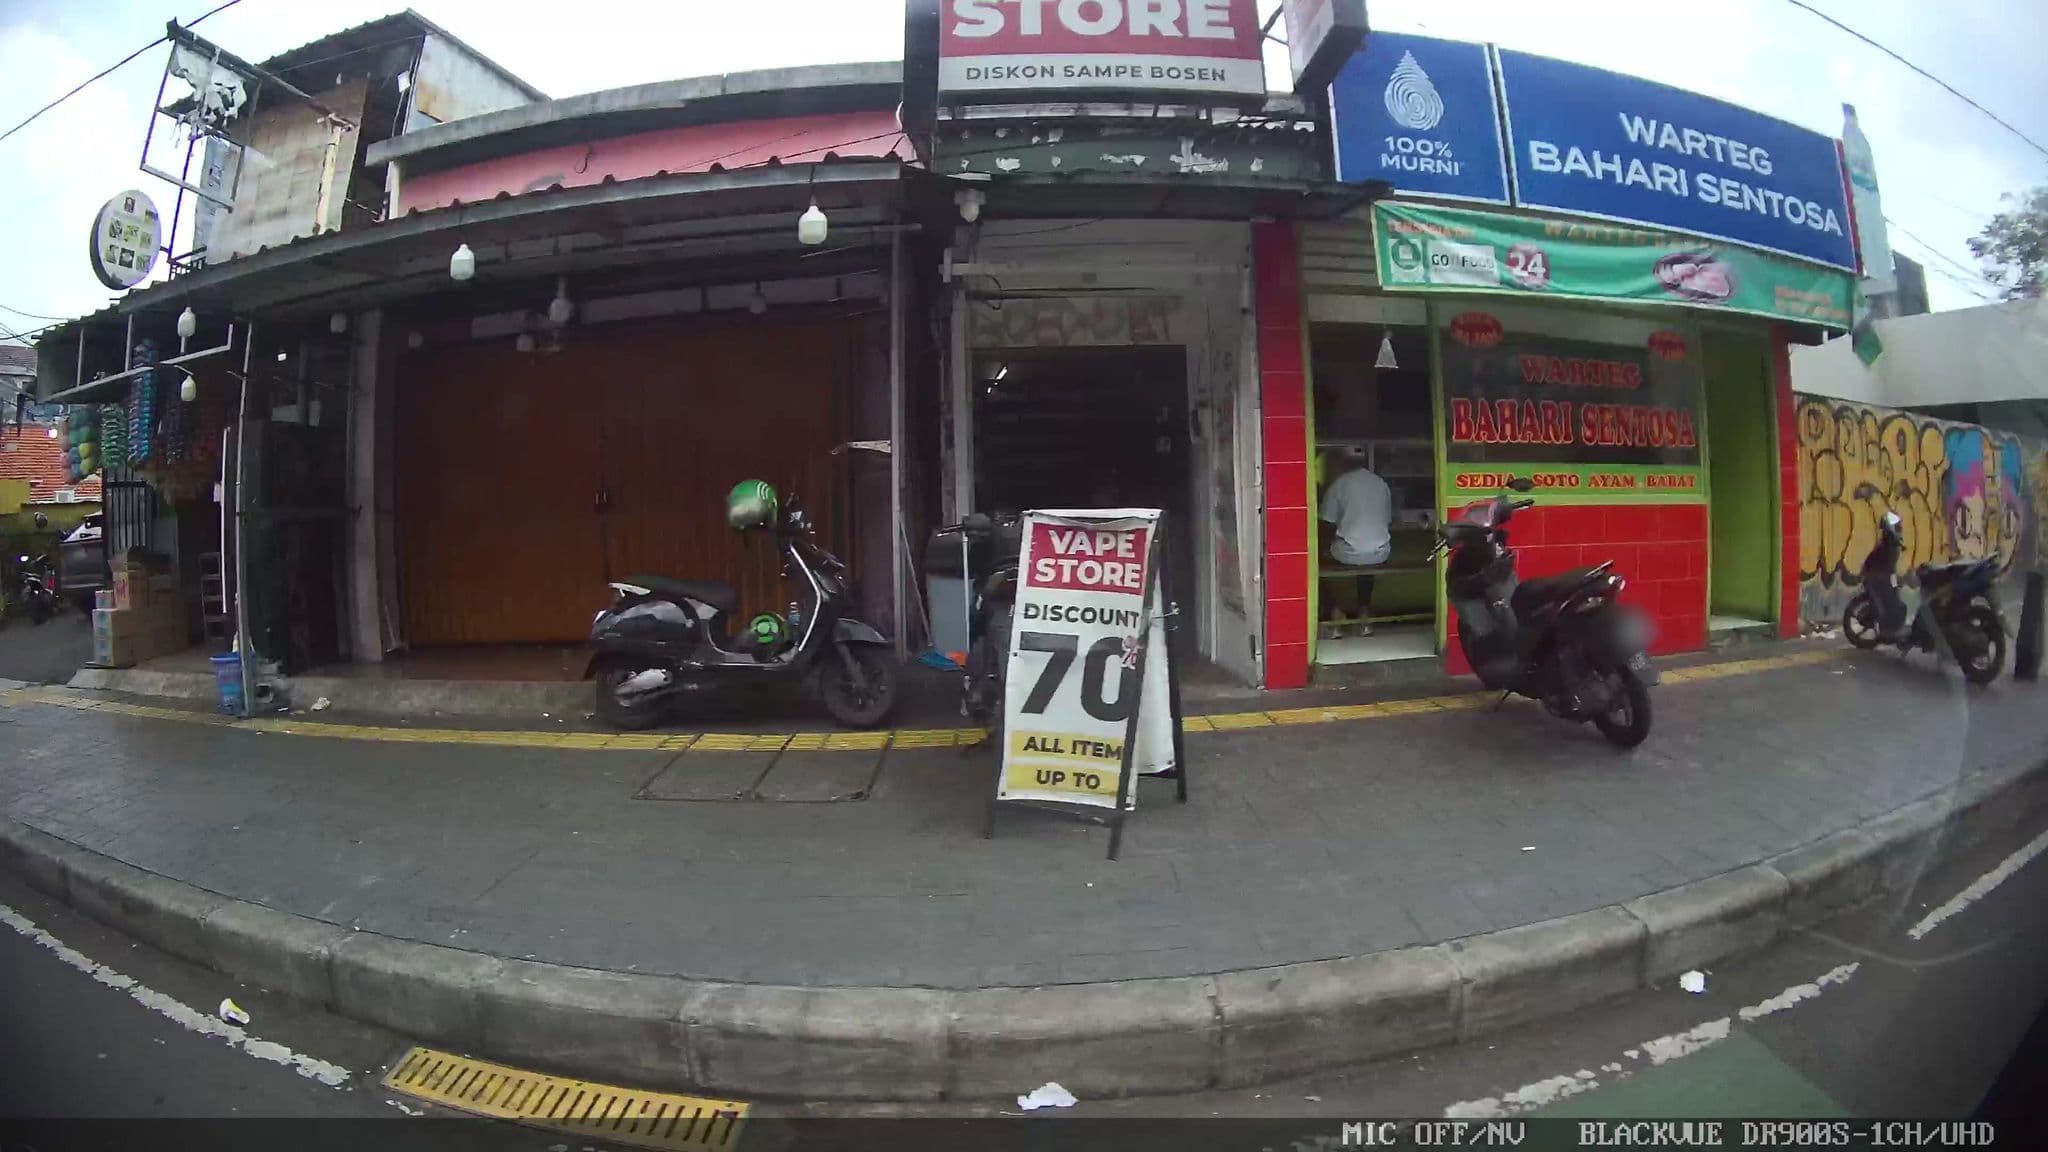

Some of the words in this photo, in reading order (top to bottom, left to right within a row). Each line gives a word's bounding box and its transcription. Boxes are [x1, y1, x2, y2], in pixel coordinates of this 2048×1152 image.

[952, 0, 1235, 40] STORE
[966, 64, 1055, 81] DISKON
[1063, 64, 1143, 79] SAMPE
[1151, 66, 1226, 82] BOSEN
[1383, 135, 1453, 159] 100%
[1619, 112, 1773, 176] WARTEG
[1381, 152, 1460, 177] MURNI
[1529, 140, 1688, 198] BAHARI
[1696, 172, 1844, 237] SENTOSA
[1510, 251, 1548, 280] 24
[1520, 354, 1643, 390] WARTEG
[1452, 397, 1575, 444] BAHARI
[1580, 403, 1697, 448] SENTOSA
[1531, 473, 1580, 489] SOTO
[1588, 474, 1636, 489] AYAM
[1049, 529, 1136, 559] VAPE
[1034, 558, 1142, 589] STORE
[1023, 602, 1140, 629] DISCOUNT
[1023, 735, 1065, 754] ALL
[1072, 739, 1124, 761] ITEM
[1035, 769, 1066, 787] UP
[1072, 772, 1101, 790] TO
